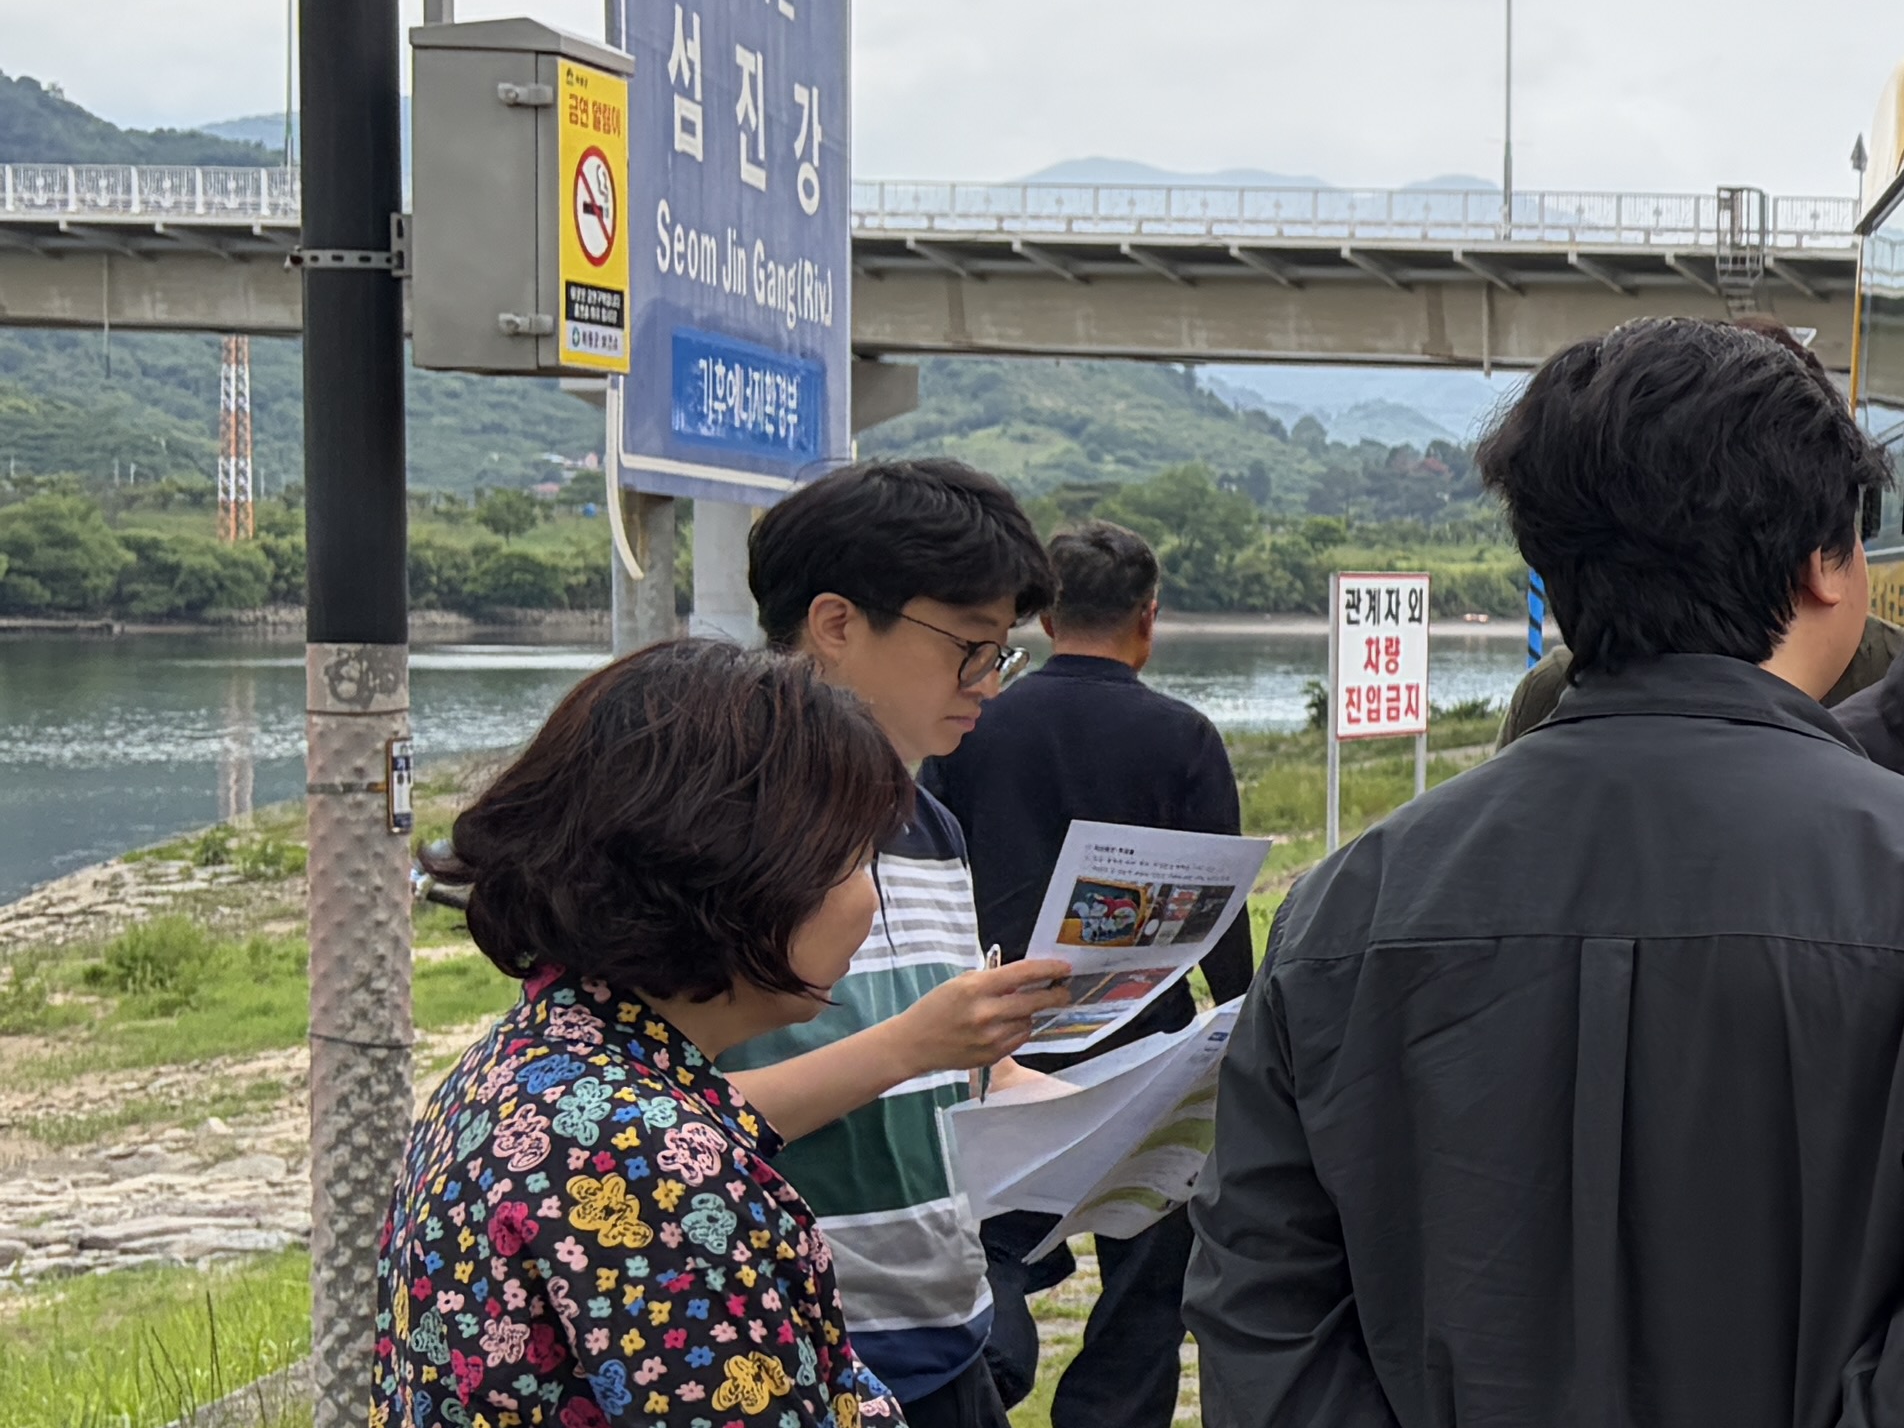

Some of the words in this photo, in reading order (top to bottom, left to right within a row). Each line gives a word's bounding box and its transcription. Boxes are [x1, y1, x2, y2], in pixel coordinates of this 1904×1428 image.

[568, 92, 589, 129] 금연
[656, 198, 718, 287] Seom
[722, 226, 747, 298] Jin
[699, 356, 801, 451] 기후에너지환경부
[1345, 587, 1401, 627] 관계자
[1407, 586, 1424, 625] 외
[1363, 635, 1401, 676] 차량
[1344, 682, 1420, 724] 진입금지
